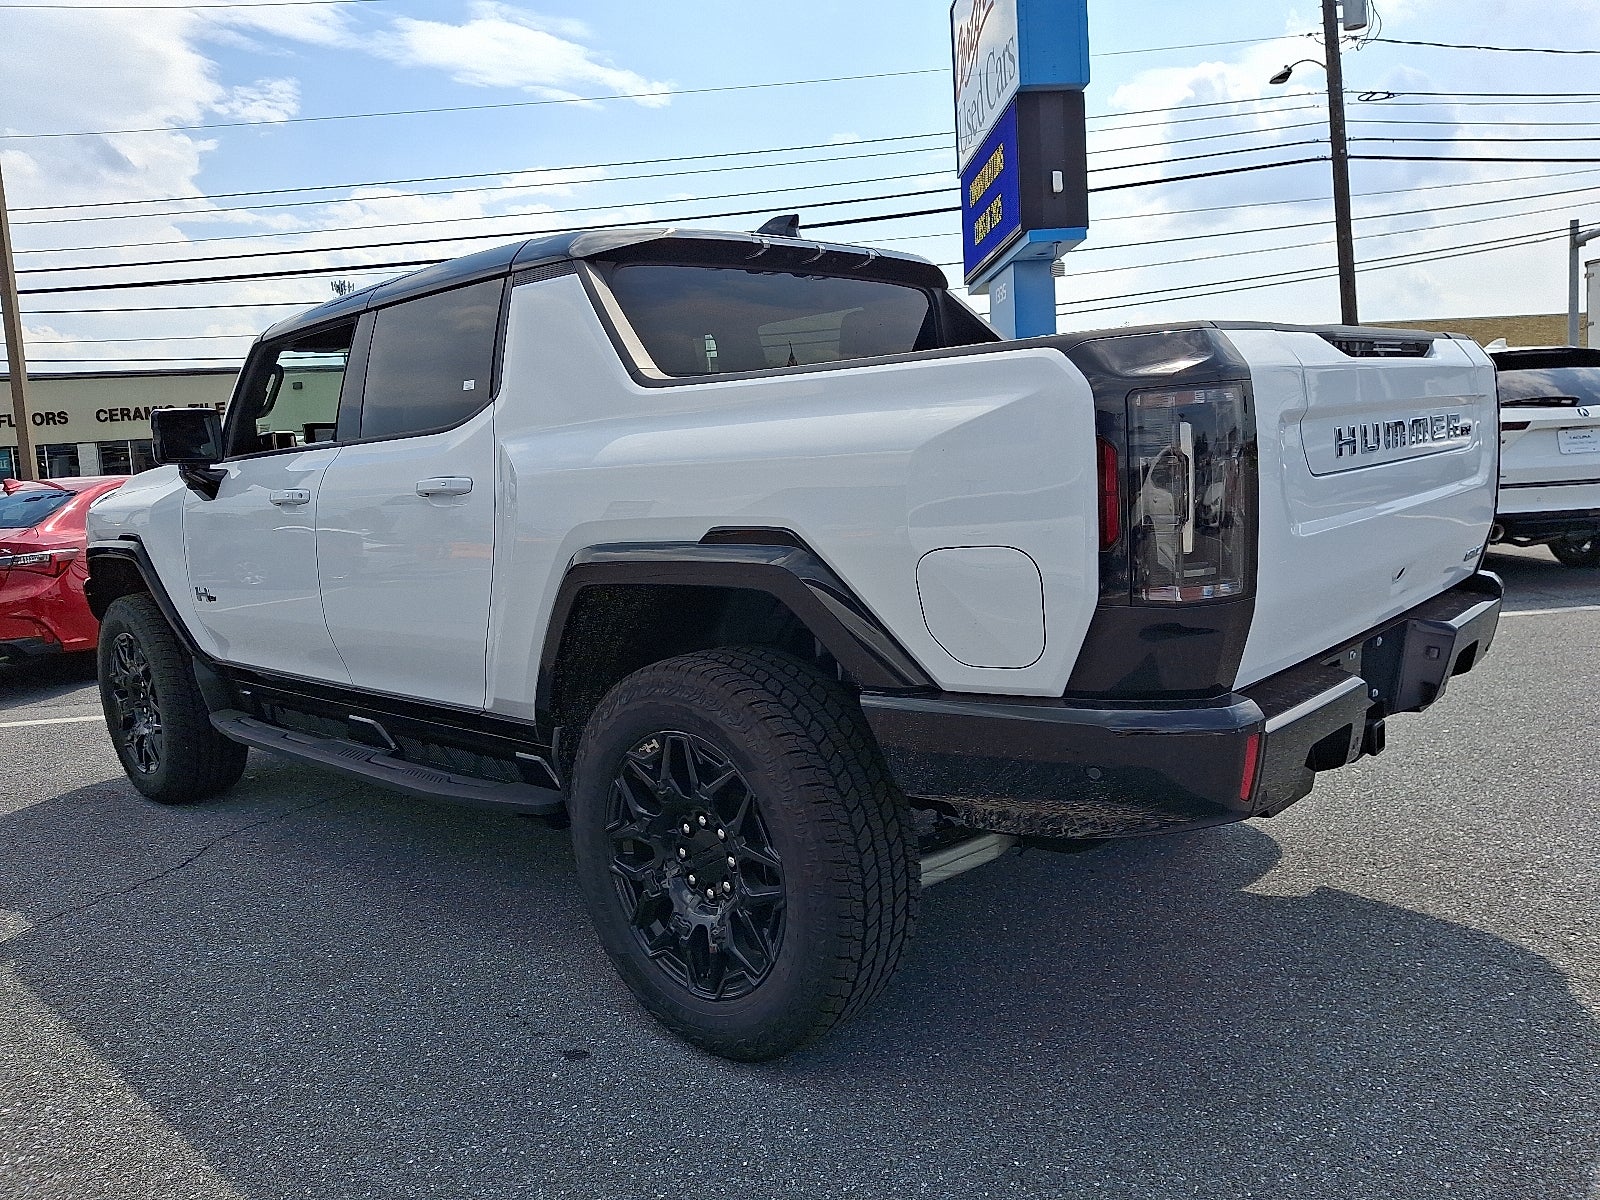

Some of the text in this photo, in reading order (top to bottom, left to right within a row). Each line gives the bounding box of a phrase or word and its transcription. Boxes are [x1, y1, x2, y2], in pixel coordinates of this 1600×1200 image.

[959, 68, 985, 154] Used
[986, 35, 1015, 110] Cars
[0, 411, 69, 428] FLORS
[95, 405, 175, 423] CERAM
[1333, 413, 1460, 458] HUMMER
